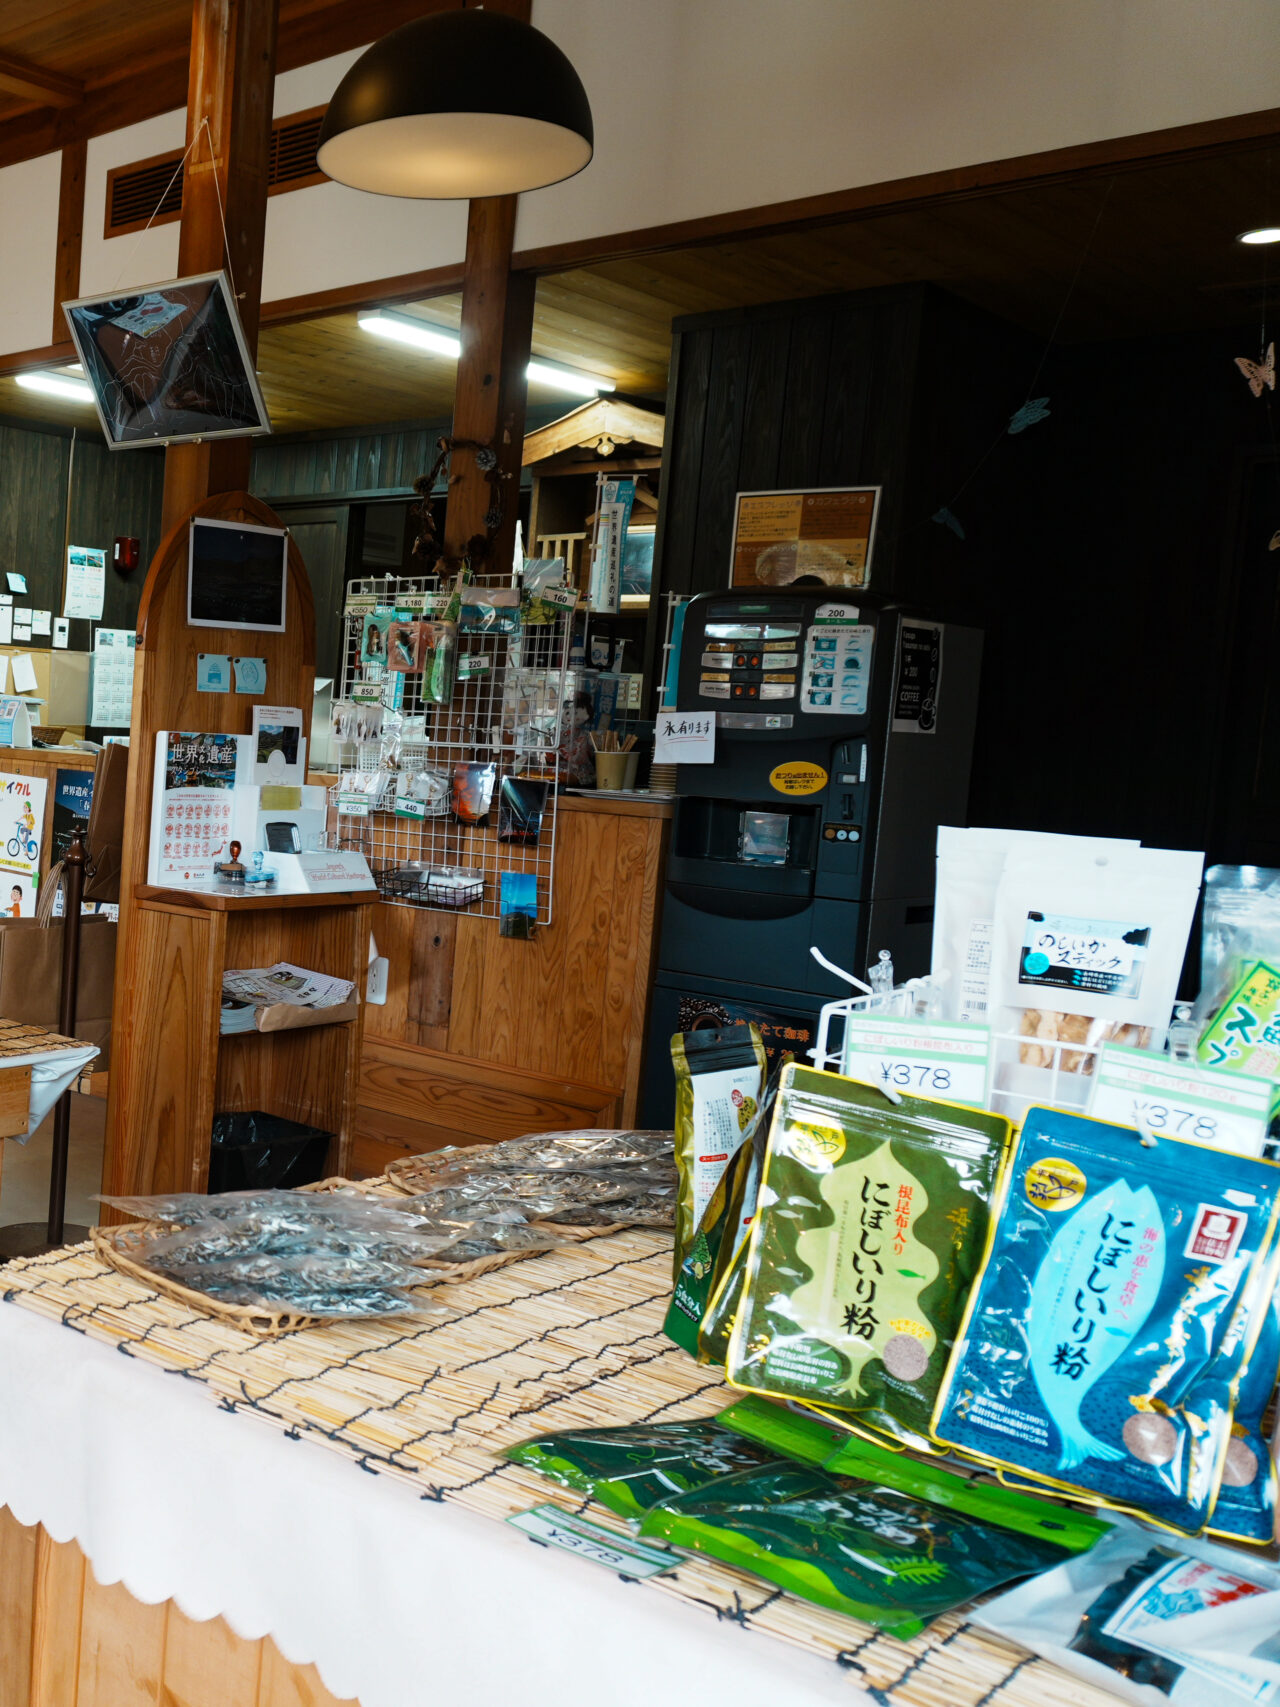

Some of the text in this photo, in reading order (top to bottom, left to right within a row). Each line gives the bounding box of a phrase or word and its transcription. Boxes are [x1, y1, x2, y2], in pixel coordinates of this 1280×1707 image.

[404, 599, 422, 607] 1,180
[436, 599, 447, 607] 220
[553, 594, 568, 603] 160
[827, 609, 845, 617] 200
[468, 660, 482, 668] 220
[361, 688, 374, 696] 850
[900, 691, 920, 702] COFFEE
[346, 805, 362, 813] ¥350
[404, 804, 417, 813] 440
[1056, 950, 1122, 969] スティック
[881, 1062, 951, 1089] ¥378
[893, 1184, 914, 1256] 根昆布入り
[840, 1175, 891, 1341] にぼしいり粉
[1049, 1212, 1134, 1381] にぼしいり粉
[548, 1529, 624, 1564] ¥378
